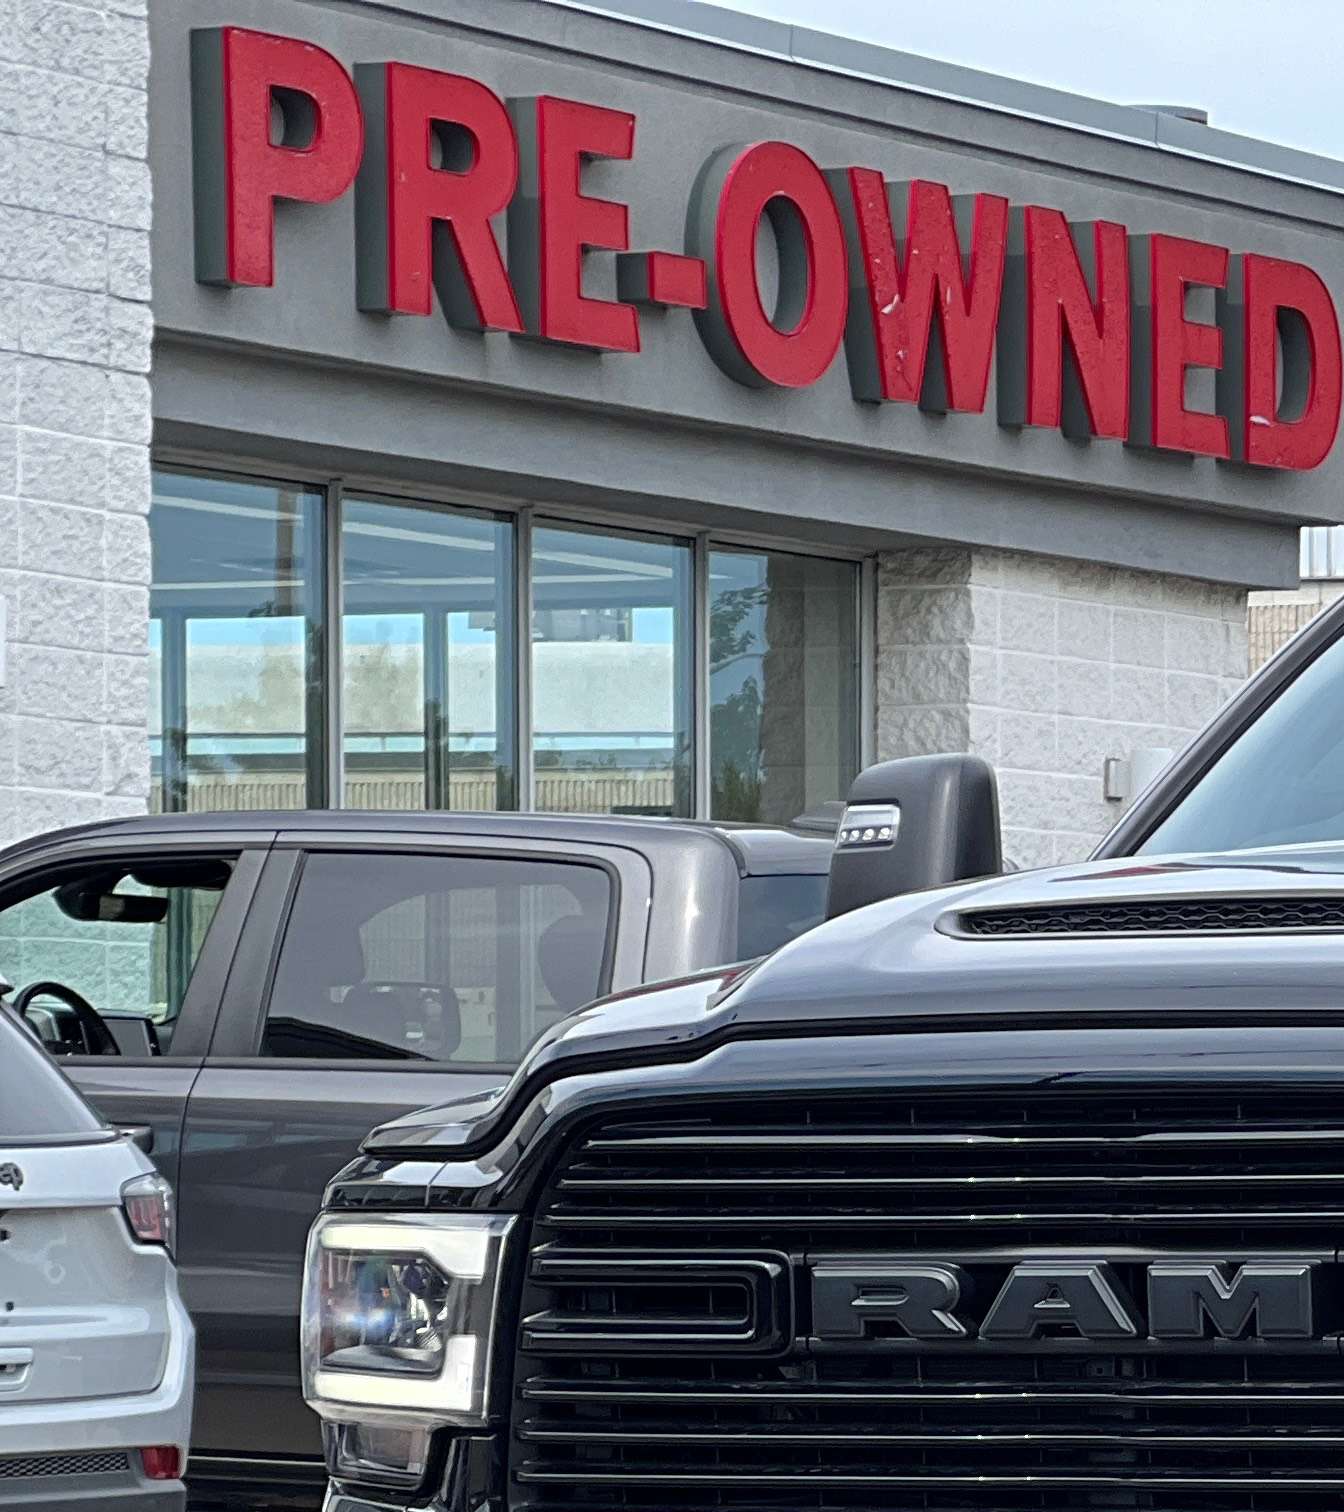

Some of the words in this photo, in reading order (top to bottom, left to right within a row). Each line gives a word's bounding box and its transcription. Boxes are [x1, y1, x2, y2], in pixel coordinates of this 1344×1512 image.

[222, 26, 1344, 470] PRE-OWNED
[0, 1163, 23, 1190] ep
[810, 1258, 1321, 1341] RAM
